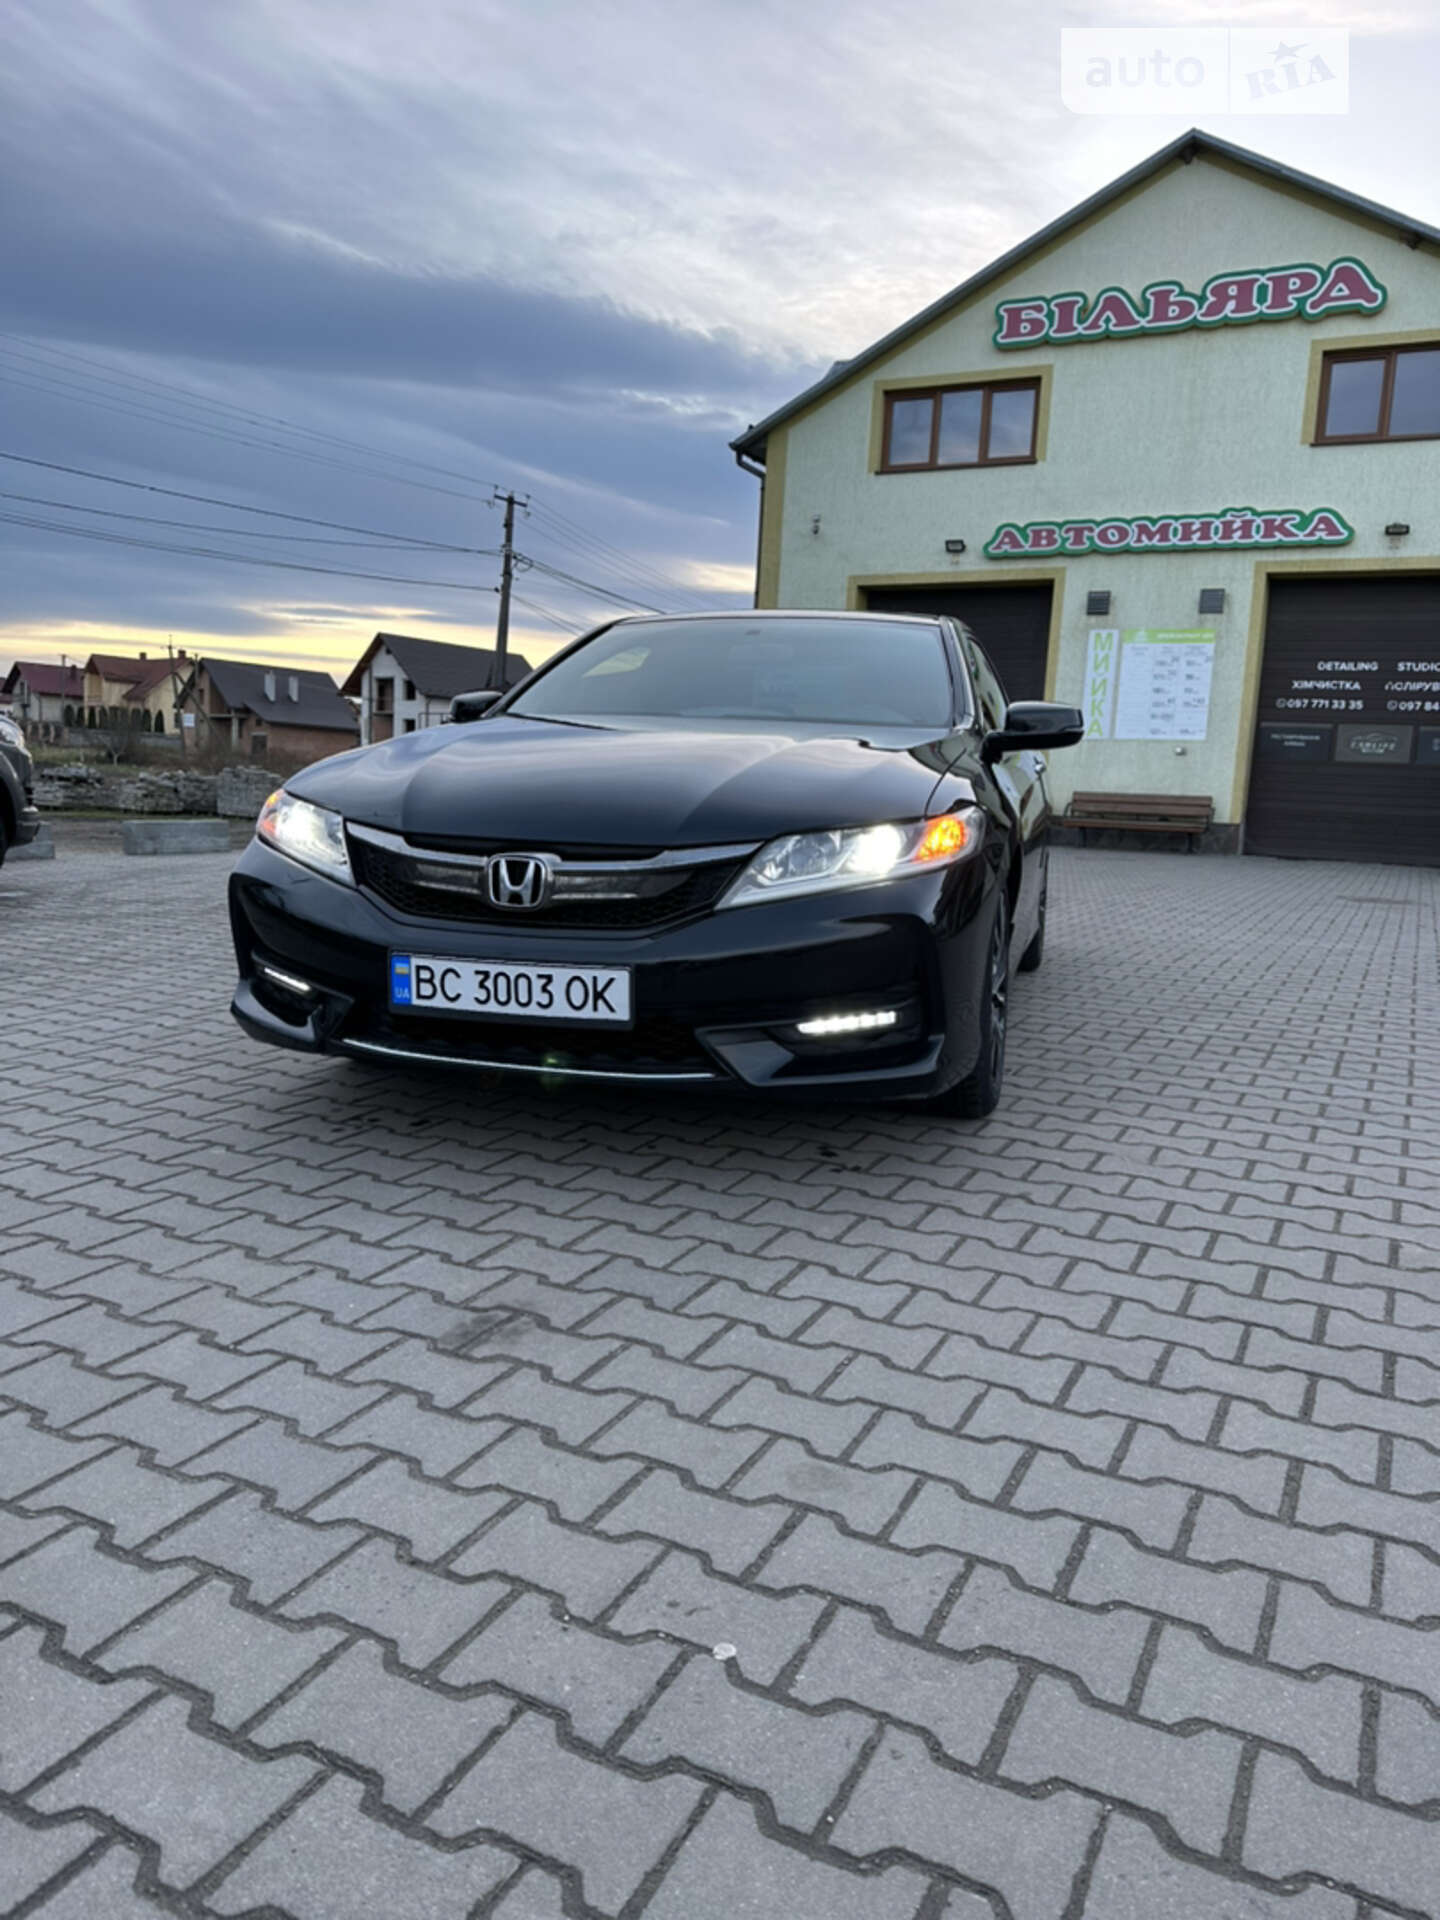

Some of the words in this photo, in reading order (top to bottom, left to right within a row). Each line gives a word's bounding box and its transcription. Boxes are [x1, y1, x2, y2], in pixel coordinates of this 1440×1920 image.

[997, 262, 1381, 343] БІЛЬЯРД
[989, 512, 1345, 551] АВТОМИЙКА
[1316, 661, 1379, 671] DETAILING
[1087, 632, 1114, 737] МИЙКА
[1291, 680, 1361, 691] ХІМЧИСТКА
[1311, 698, 1330, 709] 771
[1348, 699, 1364, 710] 35
[1398, 700, 1422, 711] 097
[395, 987, 411, 999] UA
[415, 965, 462, 1002] BC
[473, 970, 554, 1009] 3003
[564, 975, 616, 1013] OK
